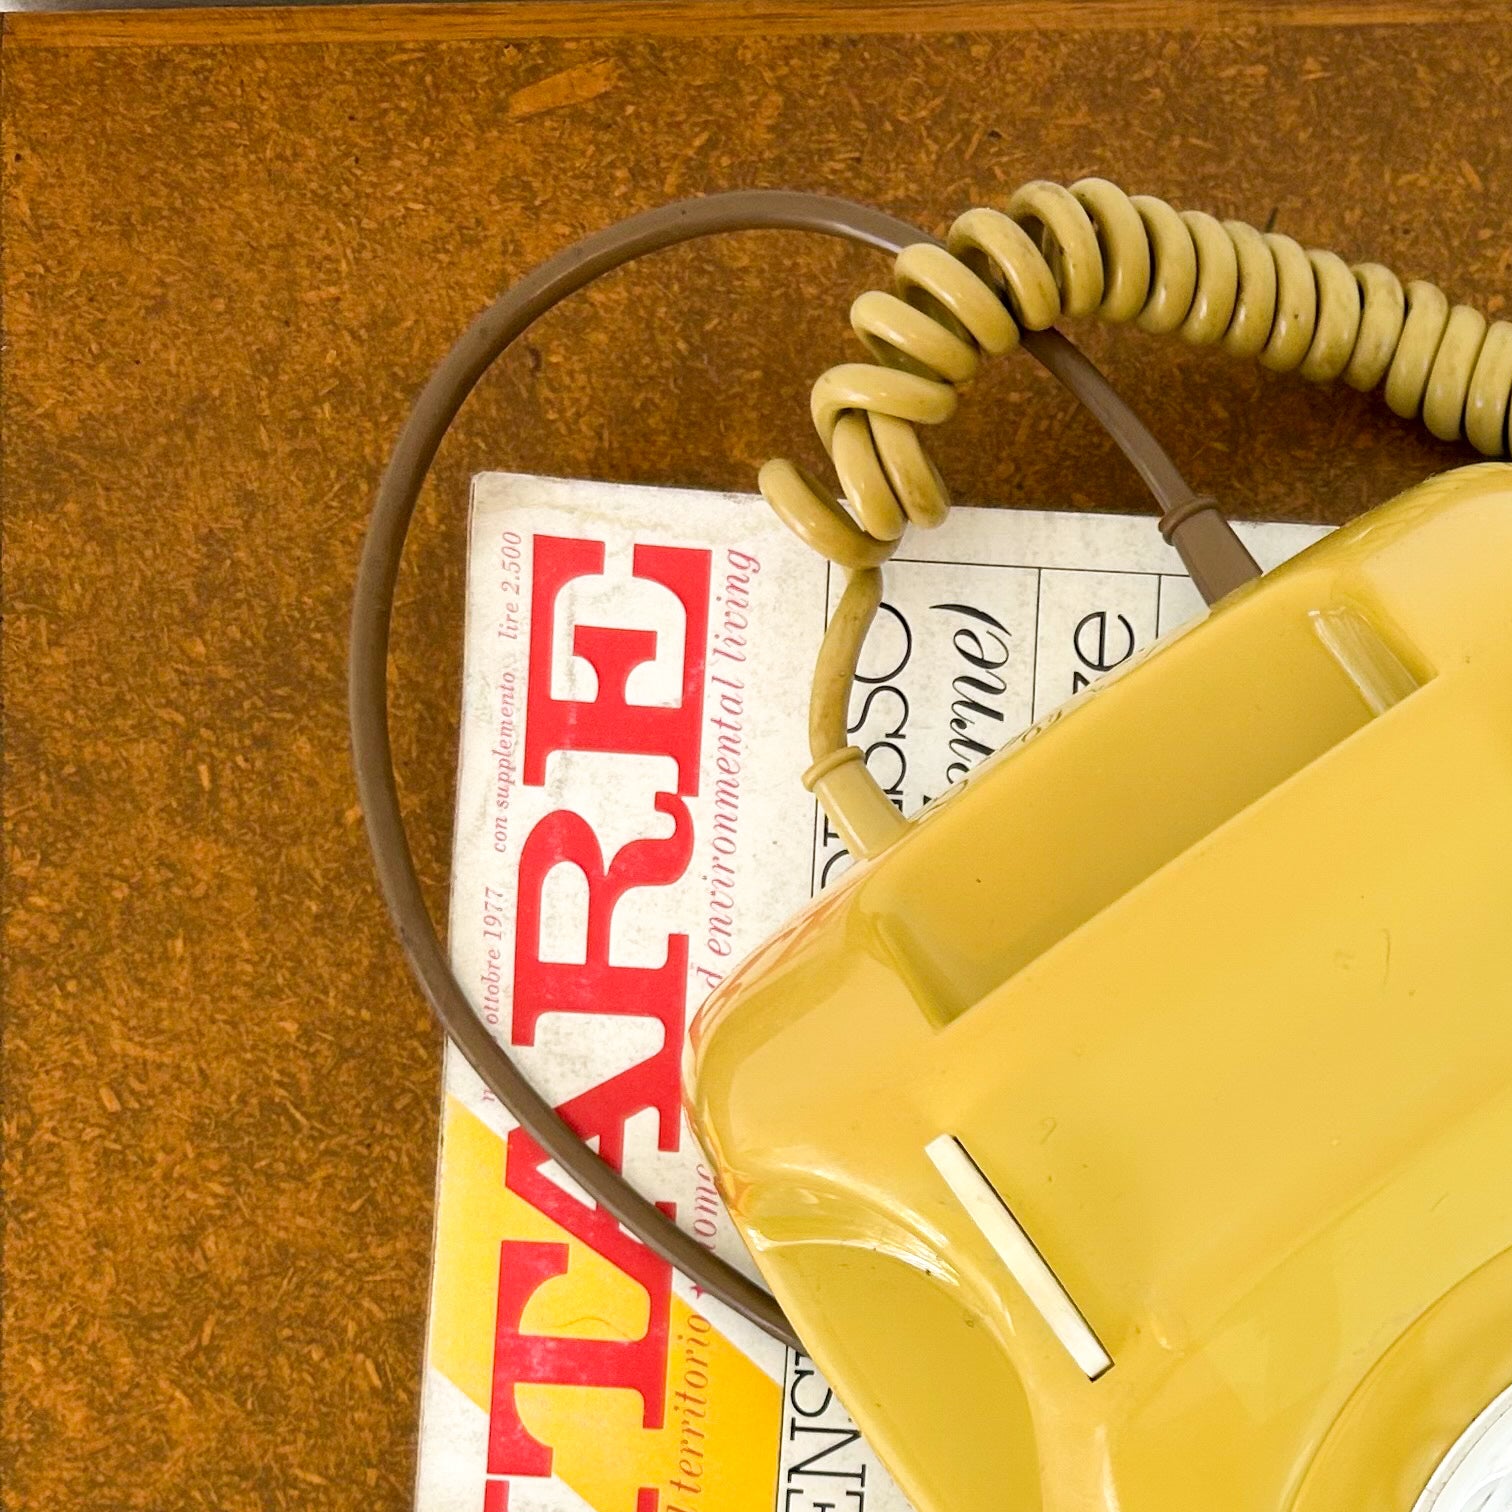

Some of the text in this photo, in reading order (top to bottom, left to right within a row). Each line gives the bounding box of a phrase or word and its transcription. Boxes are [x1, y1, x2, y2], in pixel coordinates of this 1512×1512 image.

[711, 548, 761, 663] living
[481, 531, 523, 1025] ottobre 1977 con supplemento lire 2.500
[702, 675, 746, 958] environmental
[670, 1313, 712, 1494] territorio
